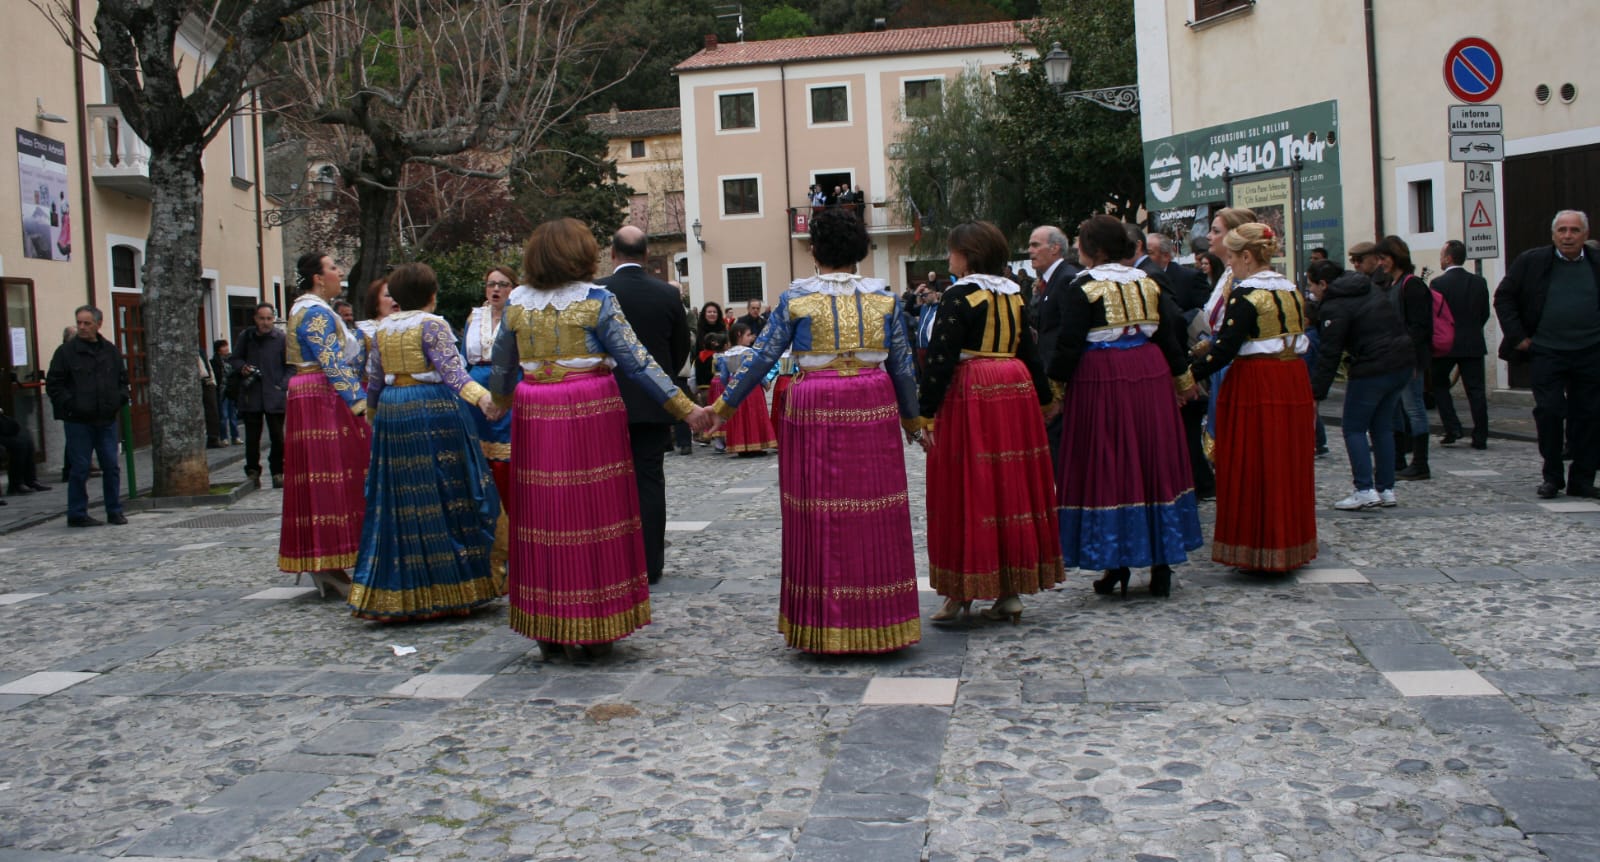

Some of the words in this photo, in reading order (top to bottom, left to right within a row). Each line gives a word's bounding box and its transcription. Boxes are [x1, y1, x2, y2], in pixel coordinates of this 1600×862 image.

[1461, 109, 1489, 118] intorno
[1262, 120, 1289, 135] POLLINO
[1452, 119, 1467, 129] alla
[1471, 119, 1500, 129] fontana
[1189, 142, 1276, 182] RAGANELLO
[1469, 169, 1491, 183] 0-24
[1160, 208, 1196, 220] CANYONING
